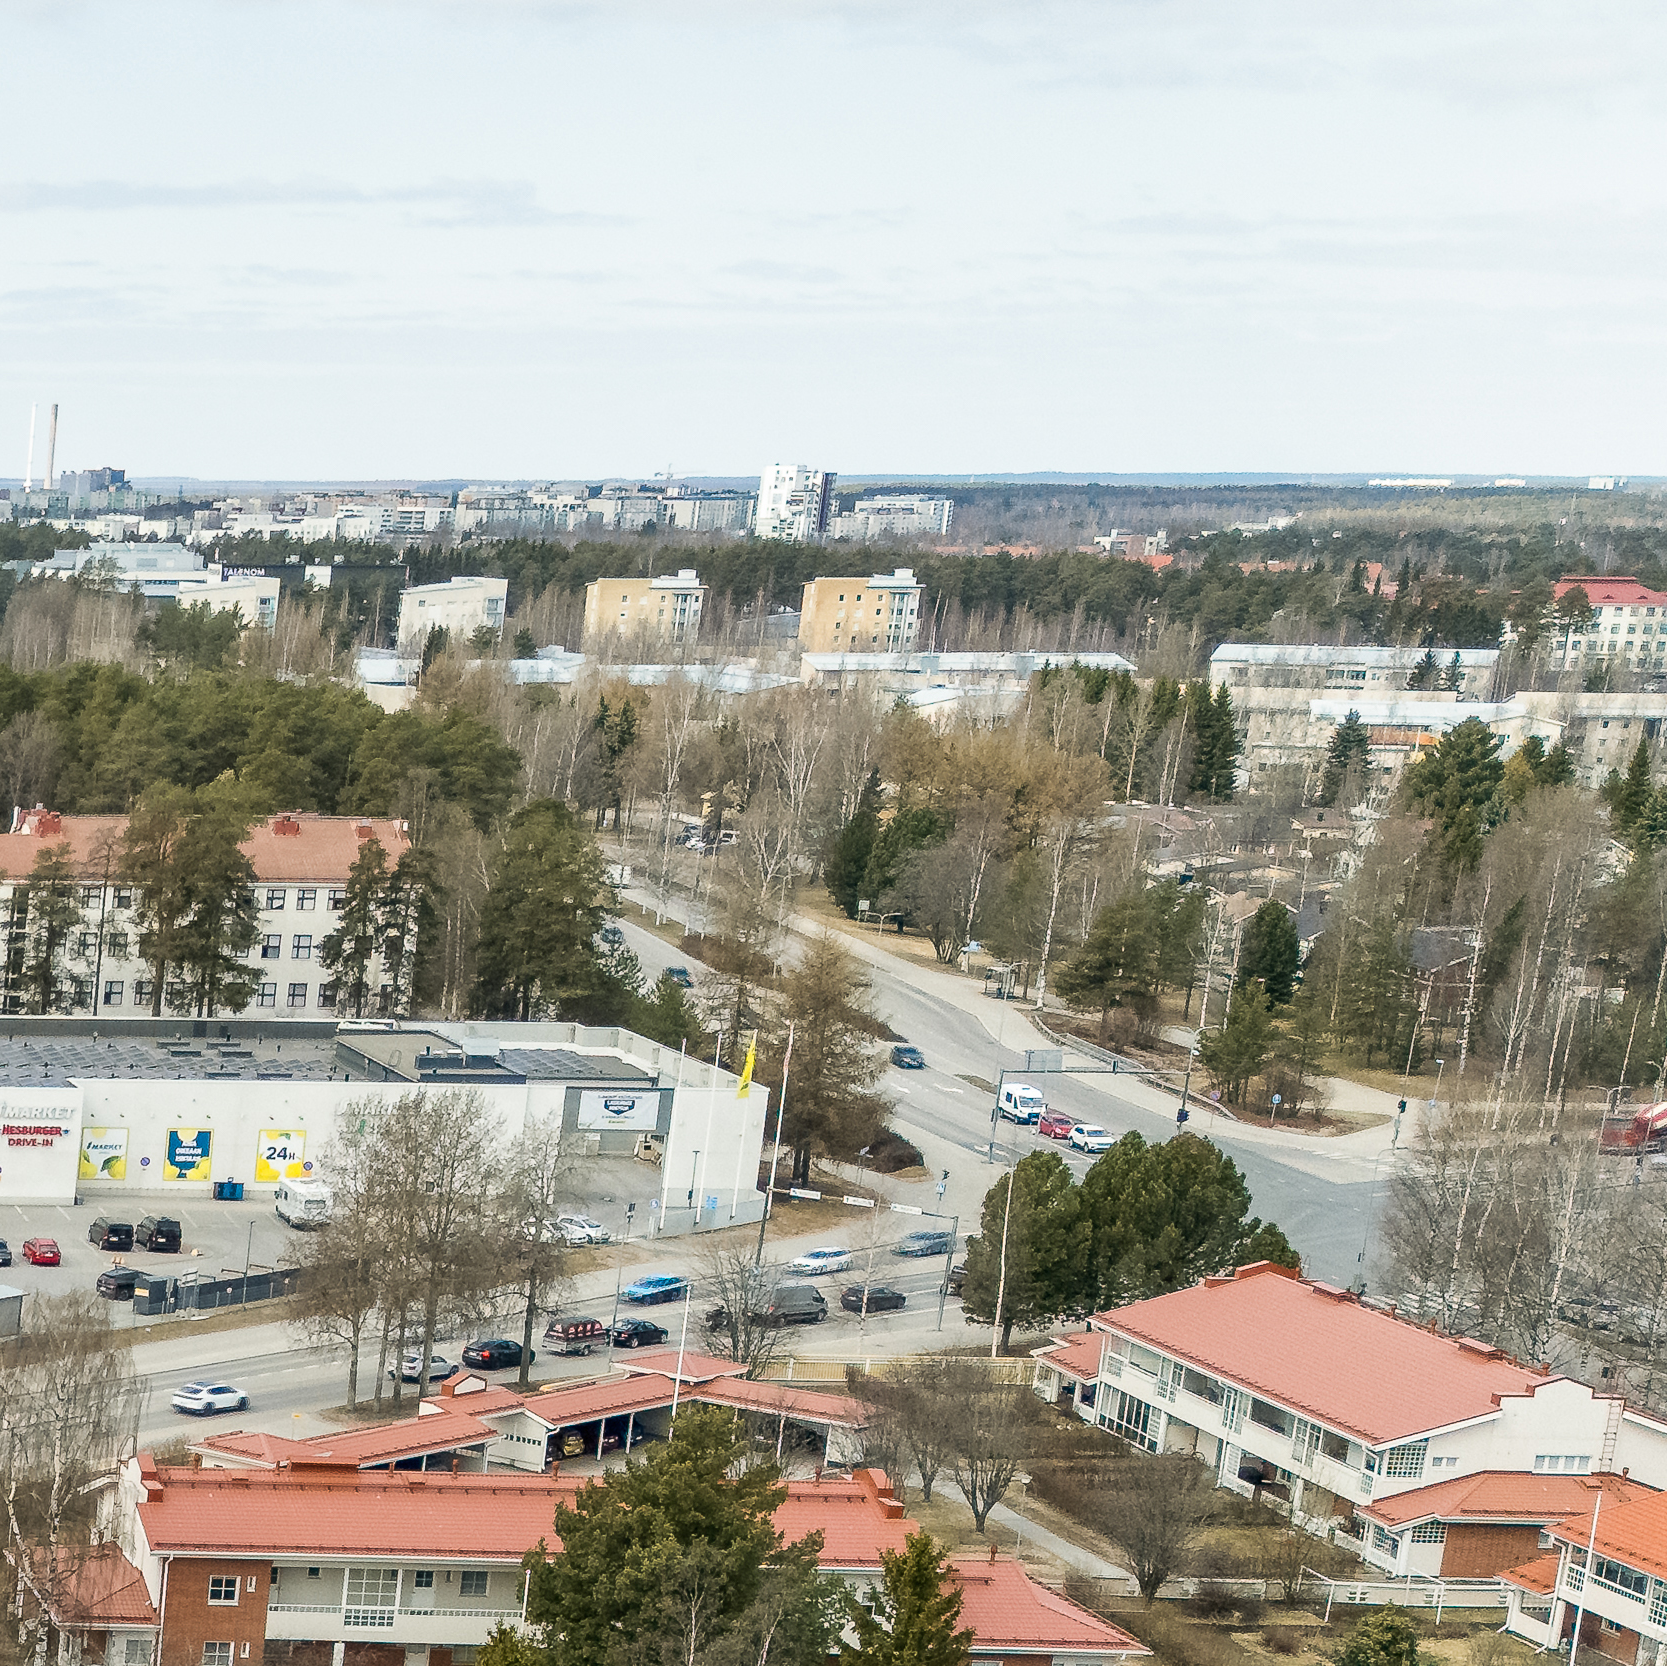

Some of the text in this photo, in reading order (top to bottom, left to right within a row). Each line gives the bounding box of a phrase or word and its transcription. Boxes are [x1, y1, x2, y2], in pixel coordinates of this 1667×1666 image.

[223, 567, 266, 576] TALENOM
[1, 1124, 63, 1137] HESBURGER
[7, 1138, 54, 1147] DRIVE-IN
